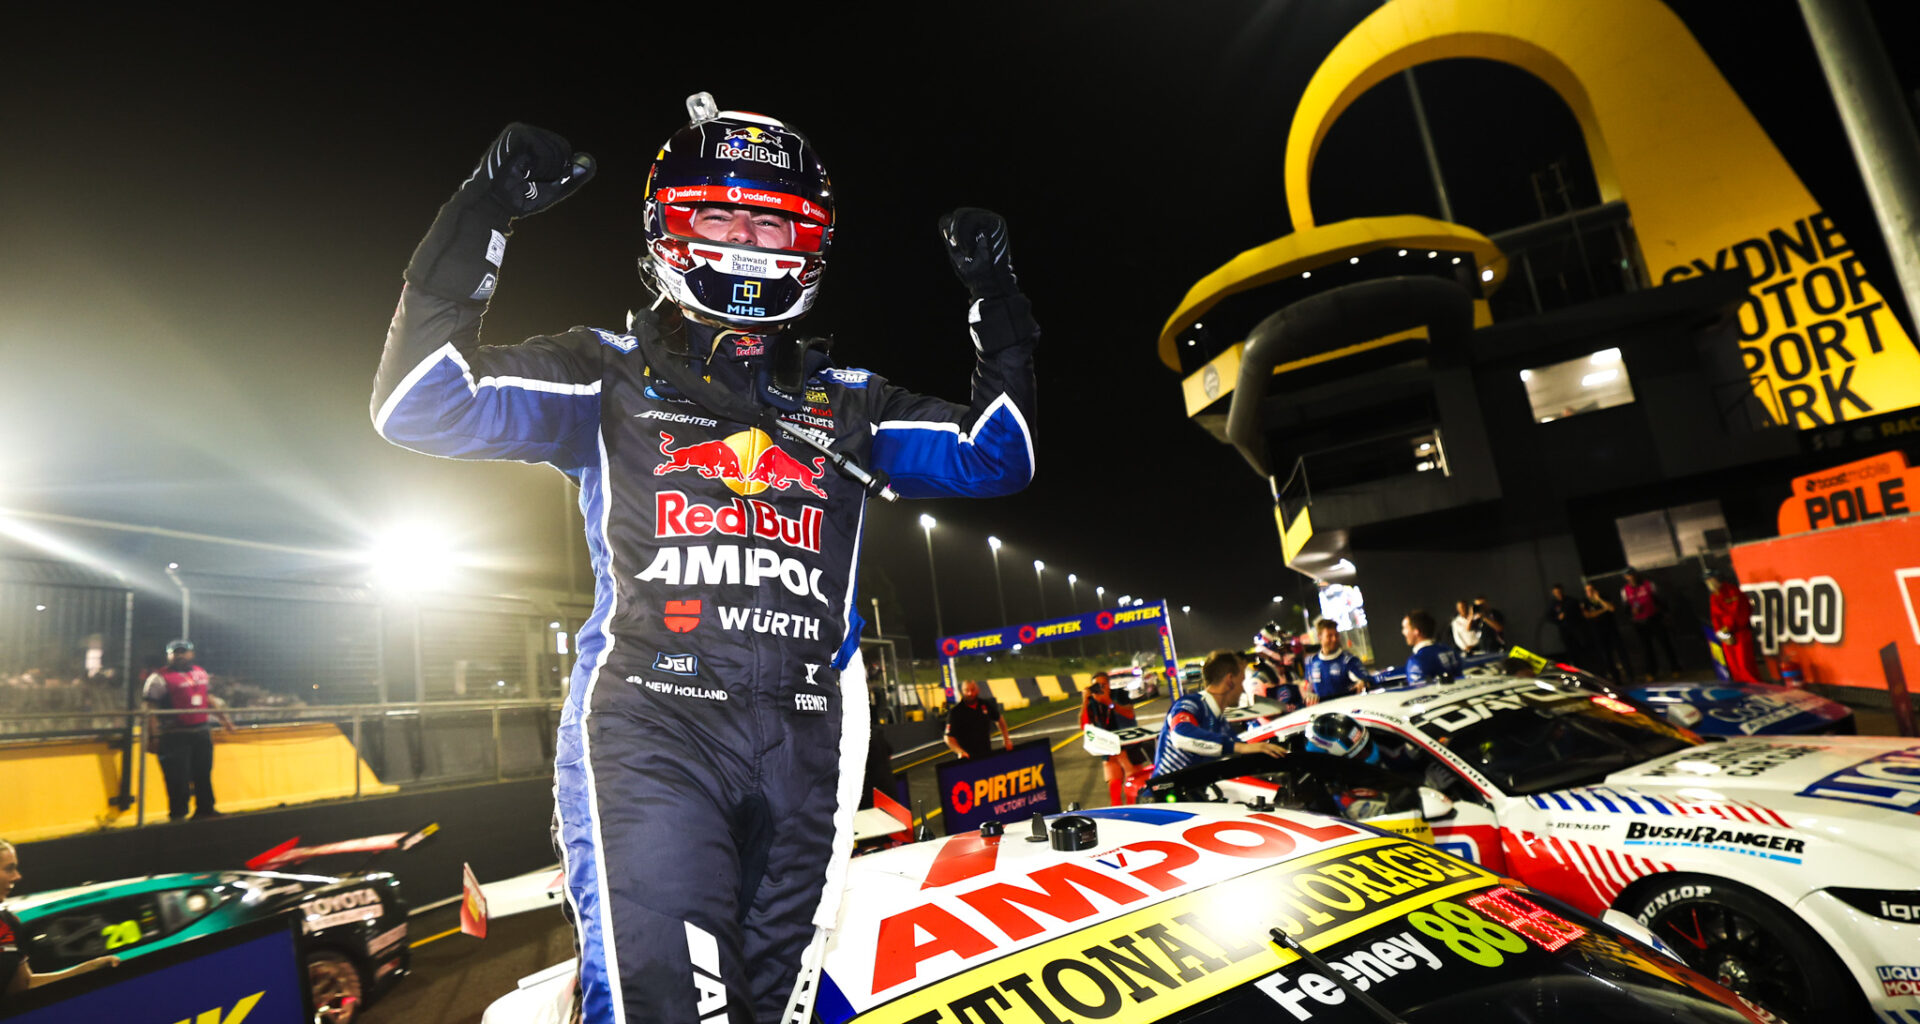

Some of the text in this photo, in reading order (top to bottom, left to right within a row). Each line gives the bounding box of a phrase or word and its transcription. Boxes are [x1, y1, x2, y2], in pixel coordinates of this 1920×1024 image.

[716, 143, 790, 169] Red Bull
[743, 193, 781, 205] vodafone
[727, 304, 766, 317] MHS
[636, 410, 718, 427] FREIGHTER
[781, 411, 835, 429] artners
[1804, 477, 1910, 530] POLE
[654, 490, 824, 554] Red Bull
[717, 606, 821, 641] WÜRTH
[1114, 606, 1161, 624] PIRTEK
[1036, 620, 1081, 638] PIRTEK
[959, 633, 1002, 651] PIRTEK
[674, 684, 729, 701] HOLLAND
[794, 693, 829, 712] FEENEY
[974, 763, 1046, 808] PIRTEK
[993, 790, 1047, 815] VICTORY LANE
[303, 888, 382, 917] TOYOTA
[870, 813, 1360, 996] AMPOL
[1637, 885, 1712, 929] DUNLOP
[1407, 900, 1528, 968] 88
[1253, 931, 1444, 1022] Feeney
[1885, 981, 1920, 996] MOL
